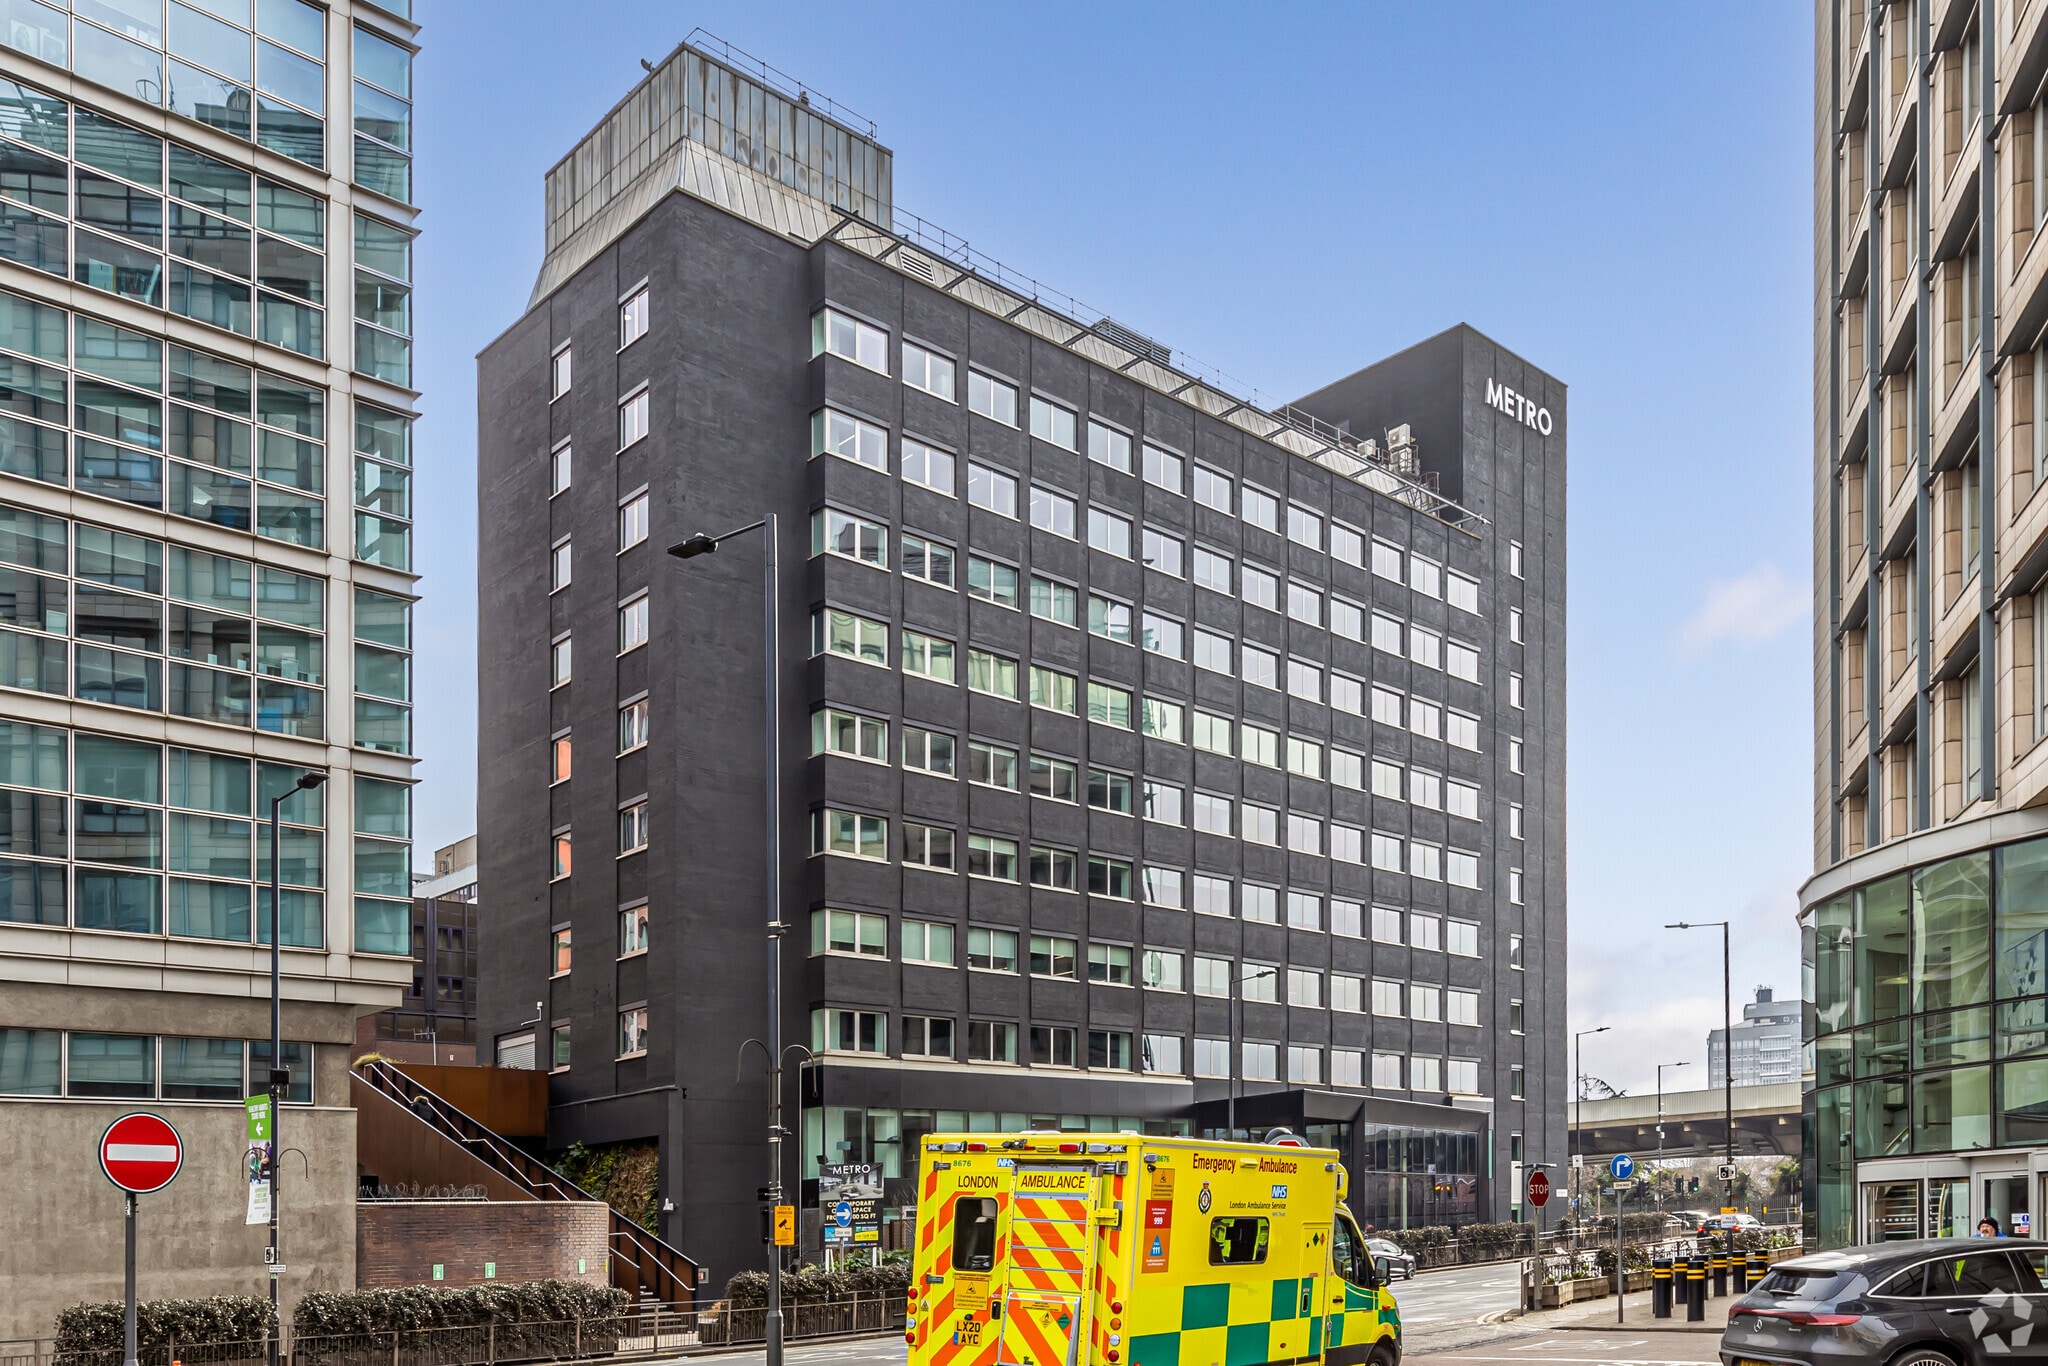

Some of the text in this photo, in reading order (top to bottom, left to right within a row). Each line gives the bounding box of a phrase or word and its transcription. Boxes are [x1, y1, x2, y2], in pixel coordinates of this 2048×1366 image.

[1485, 377, 1553, 436] METRO
[1192, 1153, 1297, 1174] Emergency Ambulance
[832, 1164, 871, 1175] METRO
[957, 1175, 1086, 1189] LONDON AMBULANCE
[1272, 1186, 1287, 1198] NHS
[1529, 1184, 1549, 1195] STOP
[1230, 1201, 1287, 1210] London Ambulance Service
[1153, 1217, 1164, 1225] 999
[1152, 1246, 1161, 1255] 111
[956, 1321, 981, 1333] LX20
[960, 1334, 979, 1344] AYC
